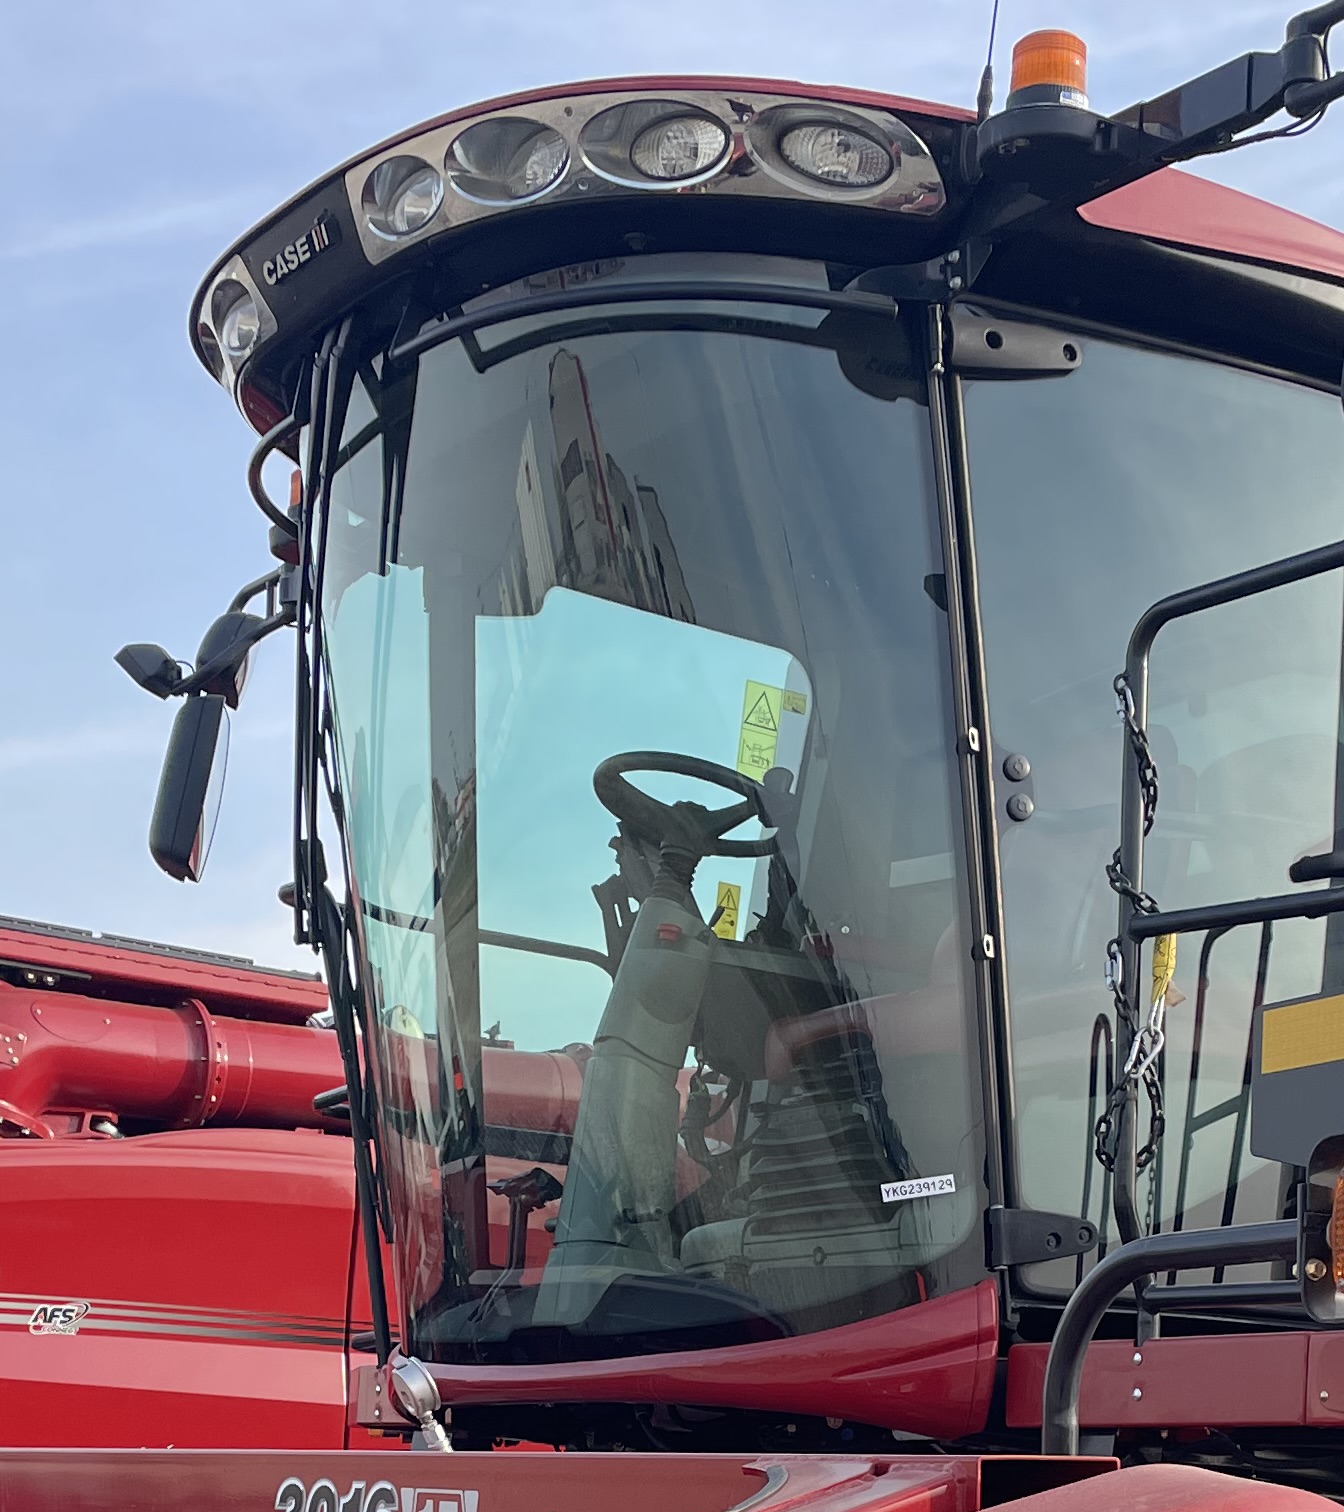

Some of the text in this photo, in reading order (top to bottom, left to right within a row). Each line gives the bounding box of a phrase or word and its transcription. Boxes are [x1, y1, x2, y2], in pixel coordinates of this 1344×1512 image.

[262, 236, 311, 285] CASE
[883, 1179, 954, 1199] YKG239129
[31, 1306, 76, 1325] AFS
